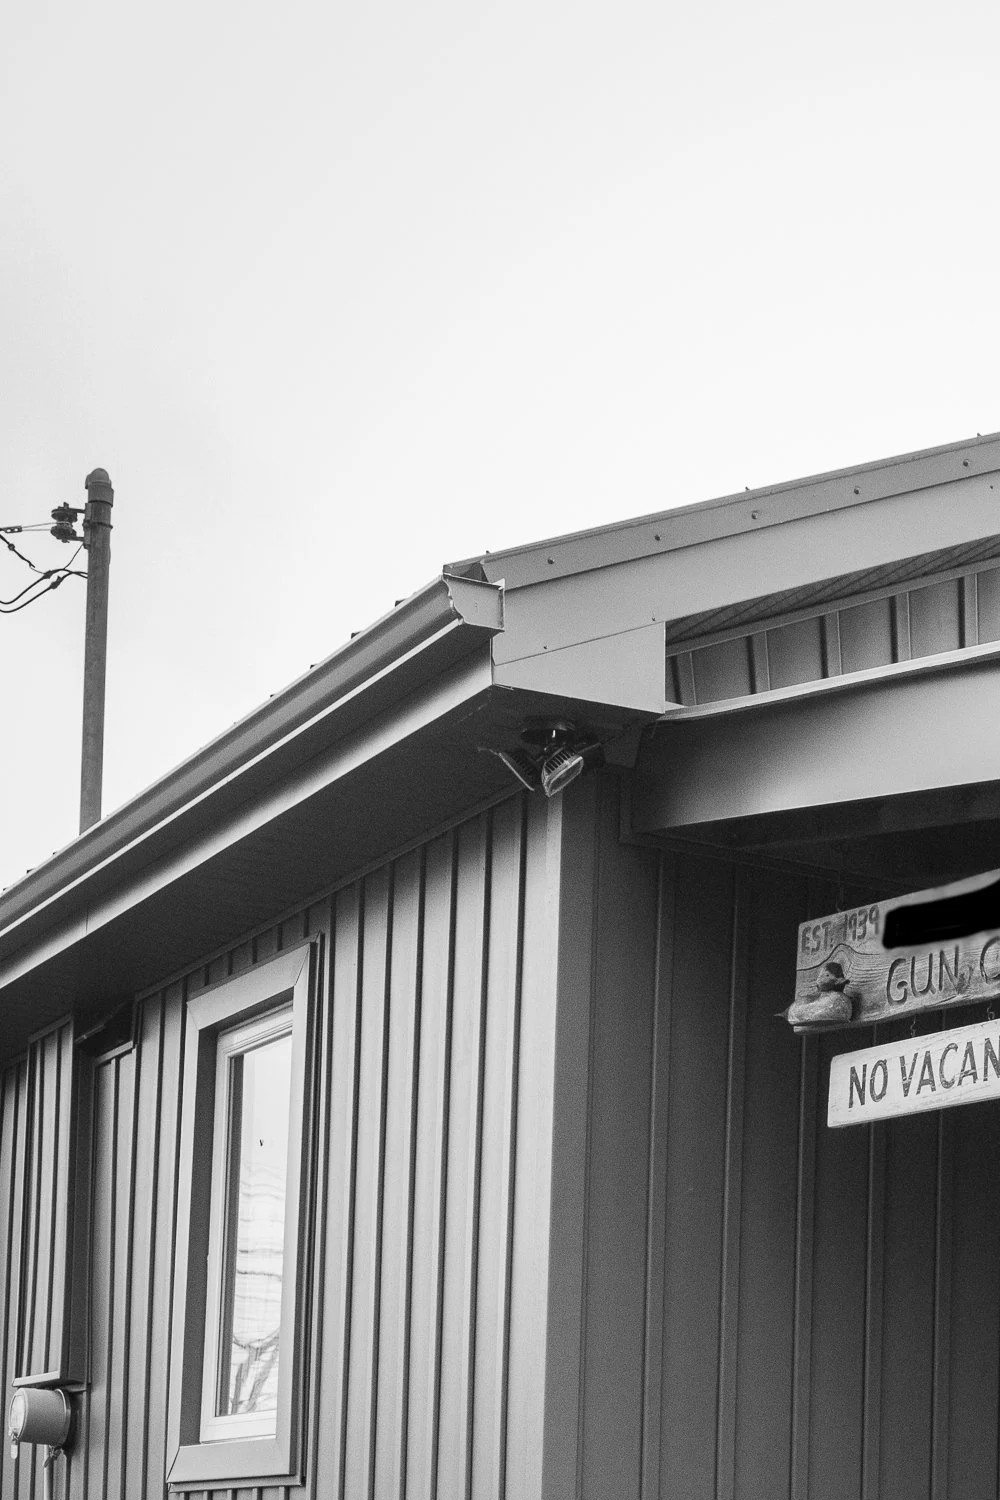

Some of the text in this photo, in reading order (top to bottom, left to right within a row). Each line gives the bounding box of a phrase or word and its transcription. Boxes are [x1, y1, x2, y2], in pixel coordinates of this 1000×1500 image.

[841, 904, 880, 941] 1939
[886, 944, 960, 1005] GUN
[848, 1059, 889, 1109] NO
